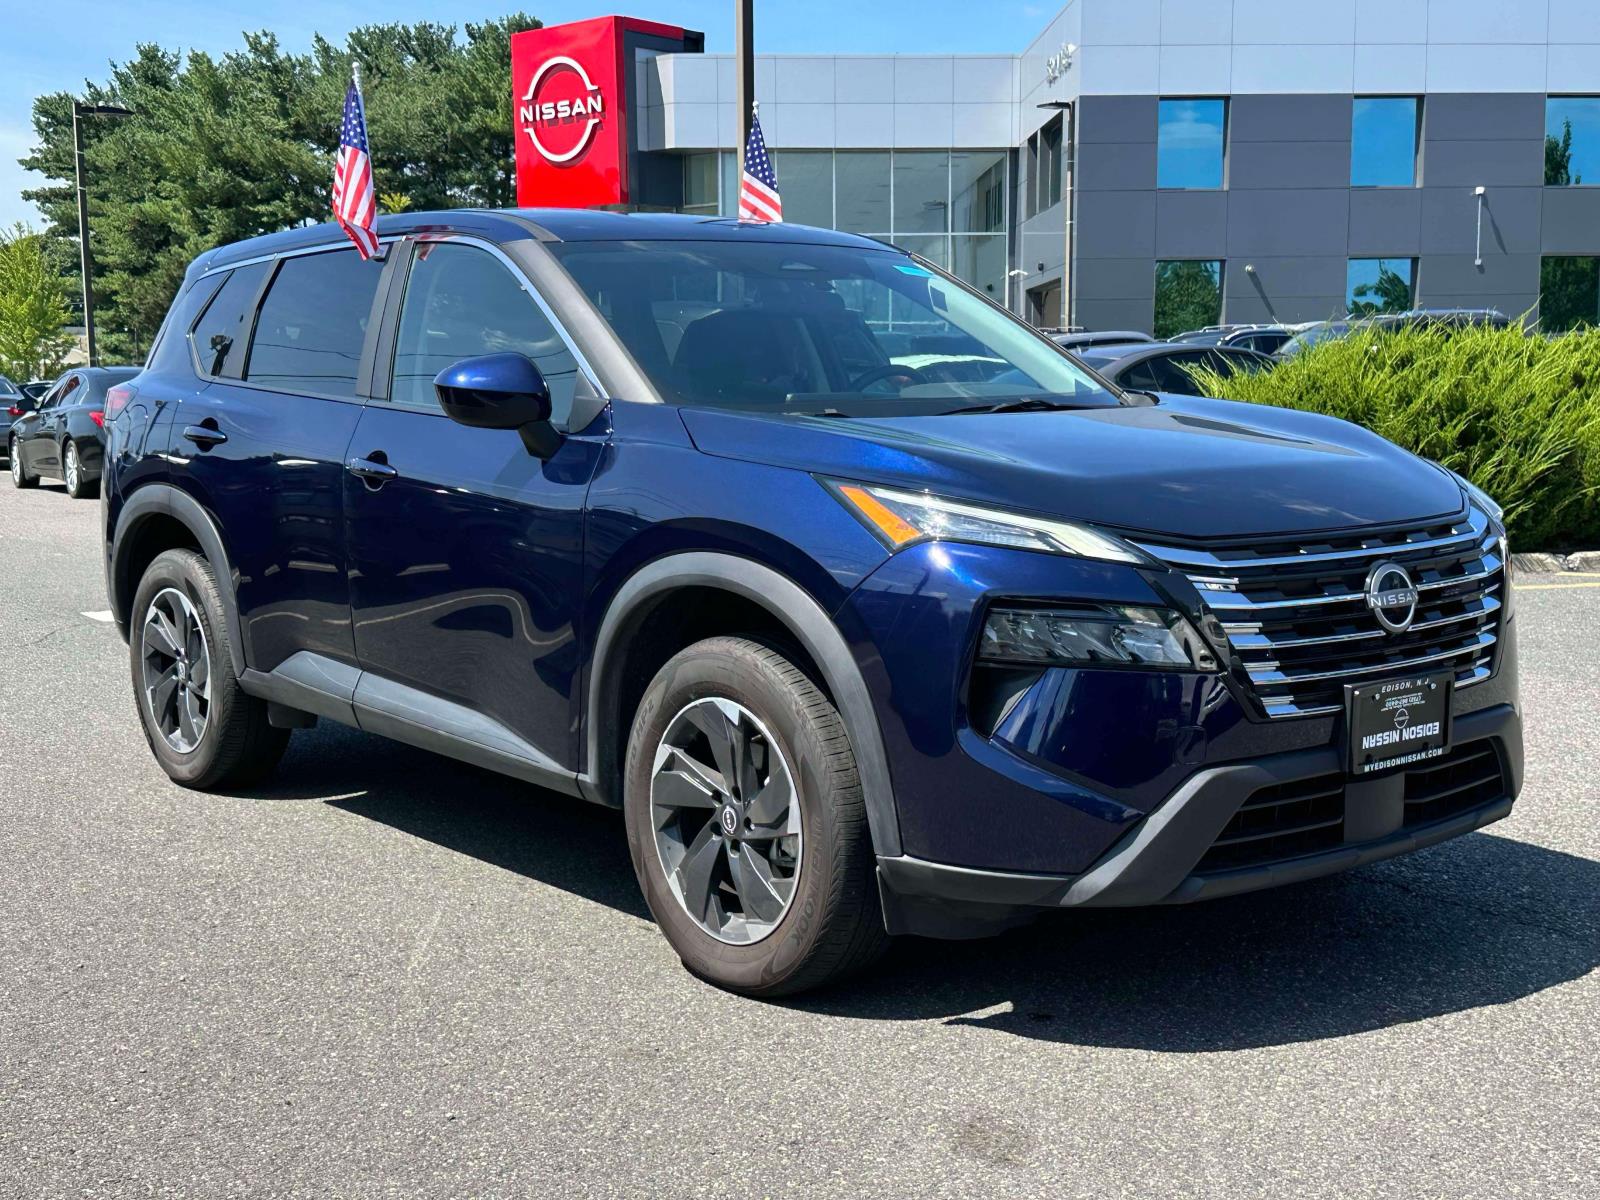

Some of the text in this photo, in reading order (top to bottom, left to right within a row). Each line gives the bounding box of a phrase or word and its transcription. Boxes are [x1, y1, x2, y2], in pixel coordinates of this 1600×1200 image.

[520, 95, 602, 123] NISSAN
[1370, 591, 1418, 607] NISSAN
[1362, 721, 1440, 749] EDISON NISSAN
[1364, 748, 1443, 772] MYEDISONNISSAN.COM
